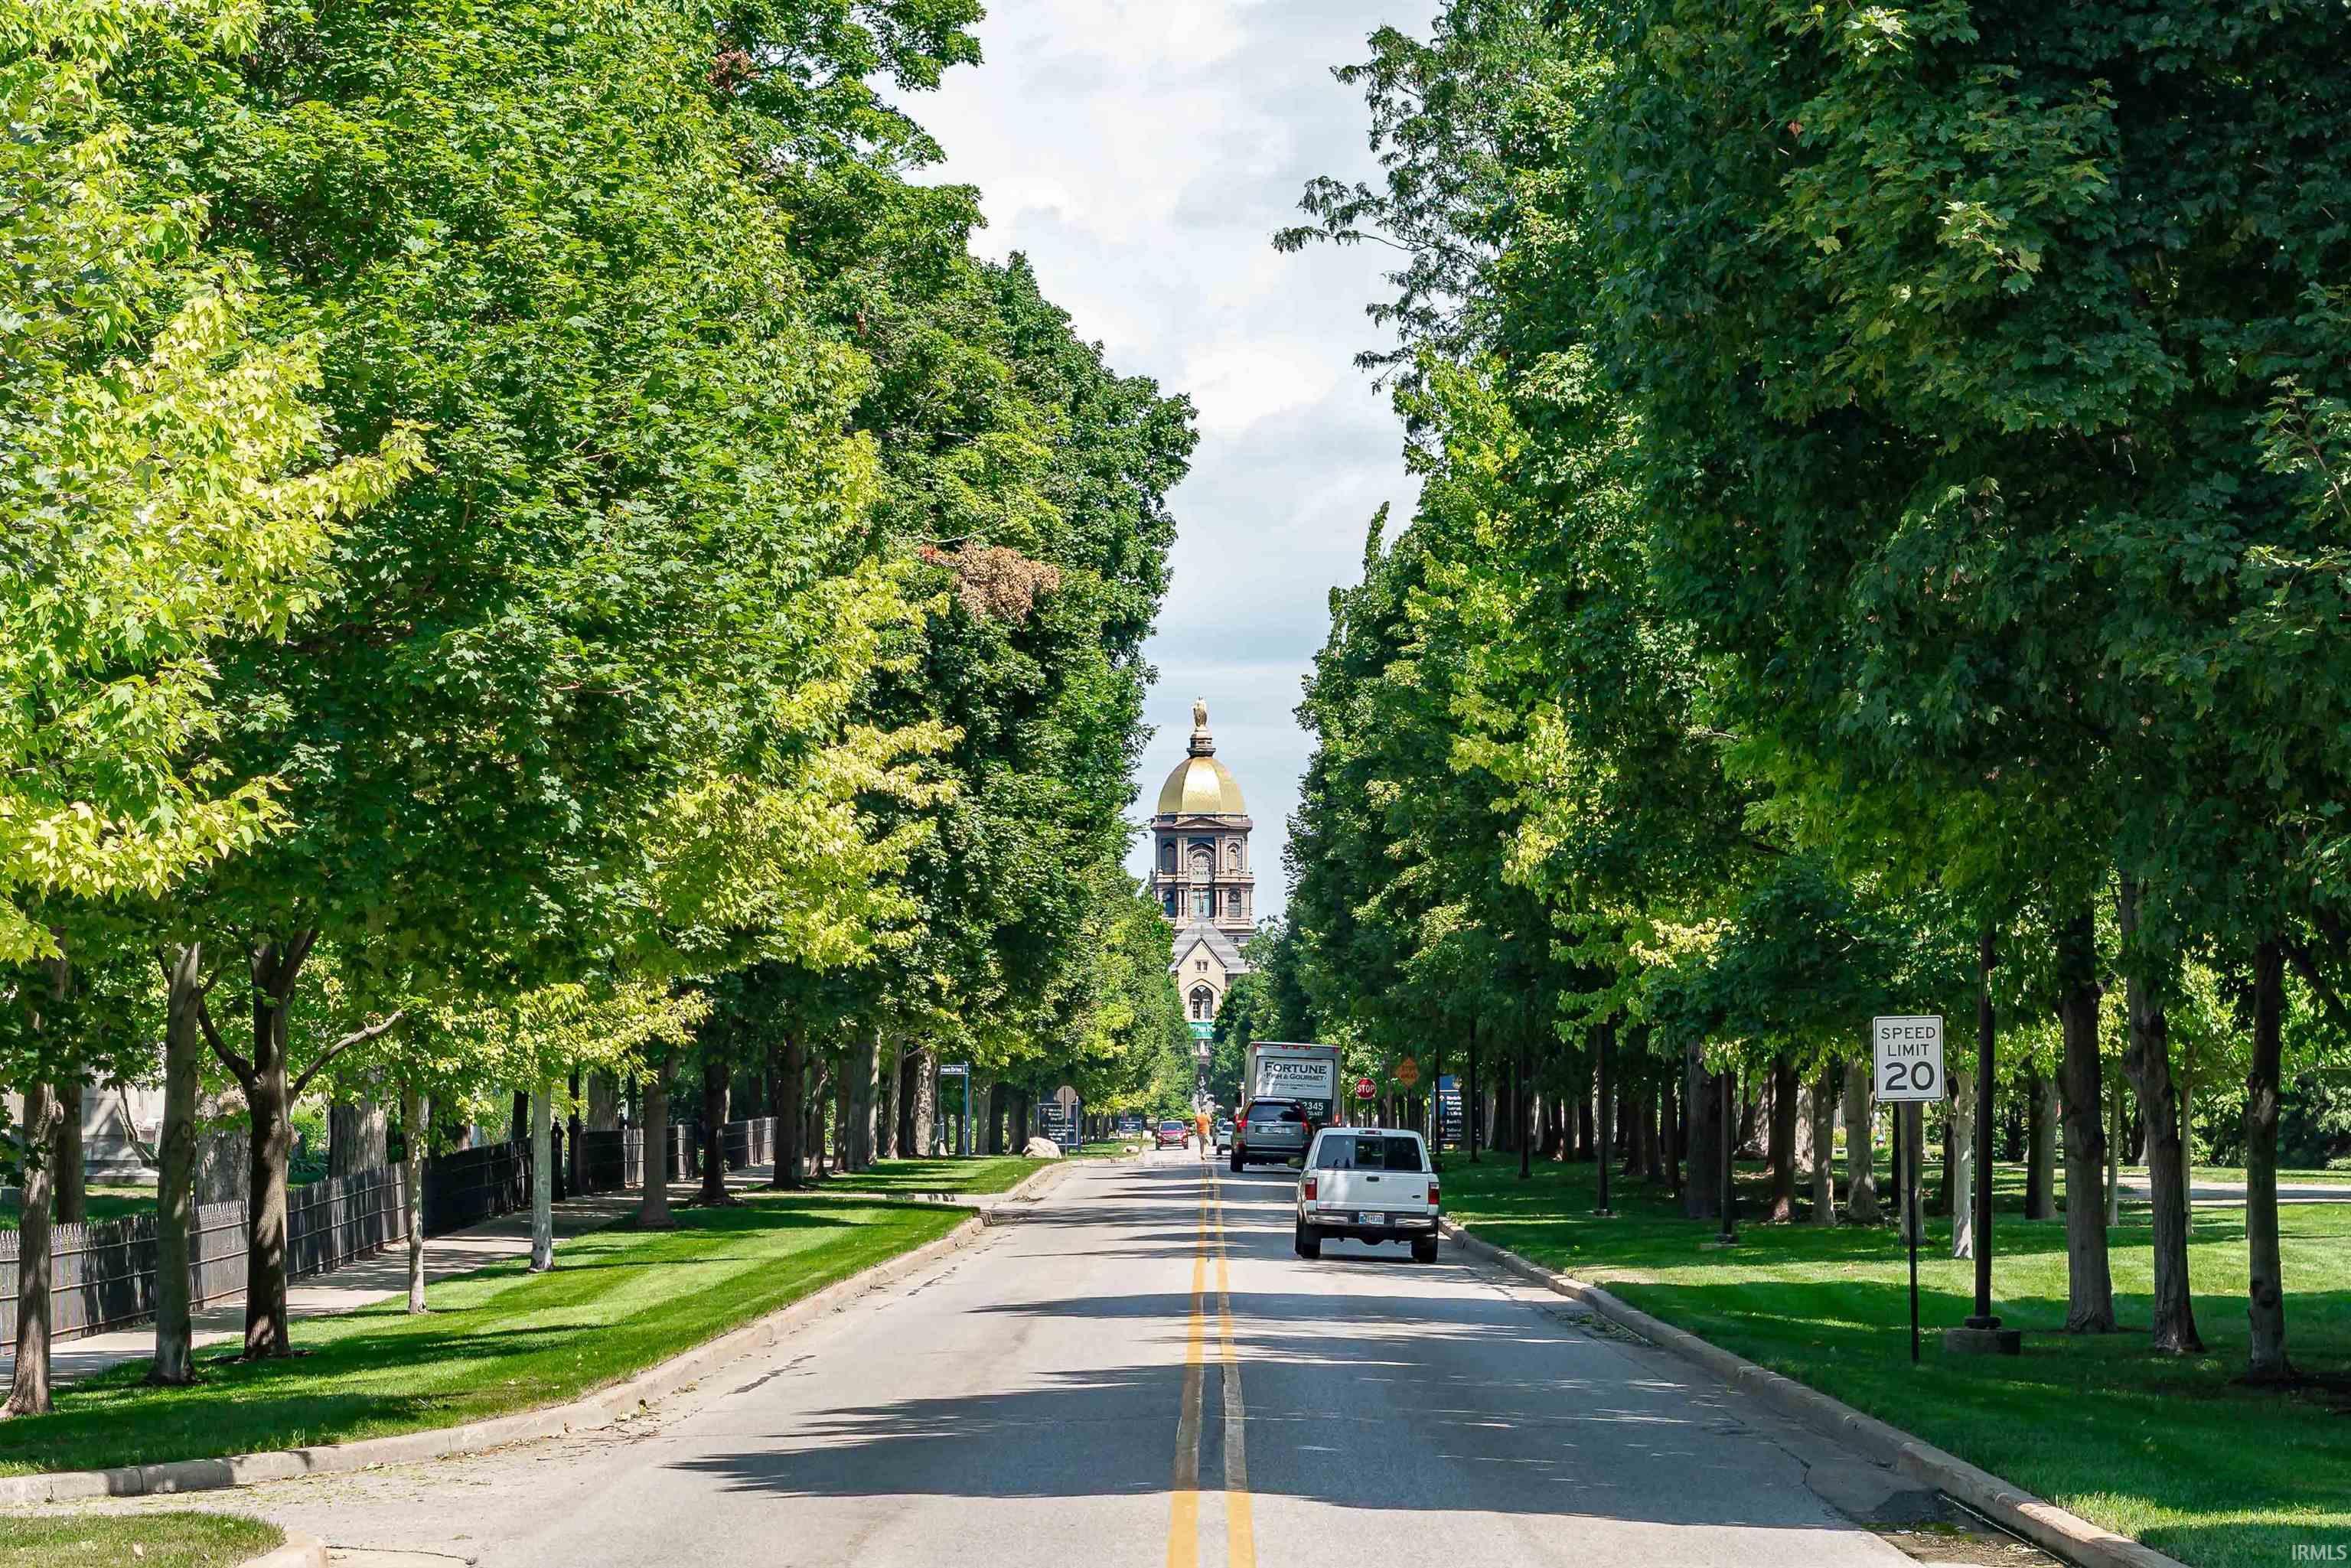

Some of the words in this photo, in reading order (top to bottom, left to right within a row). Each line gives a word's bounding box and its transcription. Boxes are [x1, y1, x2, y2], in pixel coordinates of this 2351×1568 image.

[1880, 1027, 1936, 1040] SPEED
[1887, 1044, 1929, 1057] LIMIT
[1264, 1061, 1327, 1074] FORTUNE
[1290, 1073, 1324, 1081] GOURMET
[1885, 1061, 1935, 1091] 20
[1357, 1084, 1375, 1094] STOP
